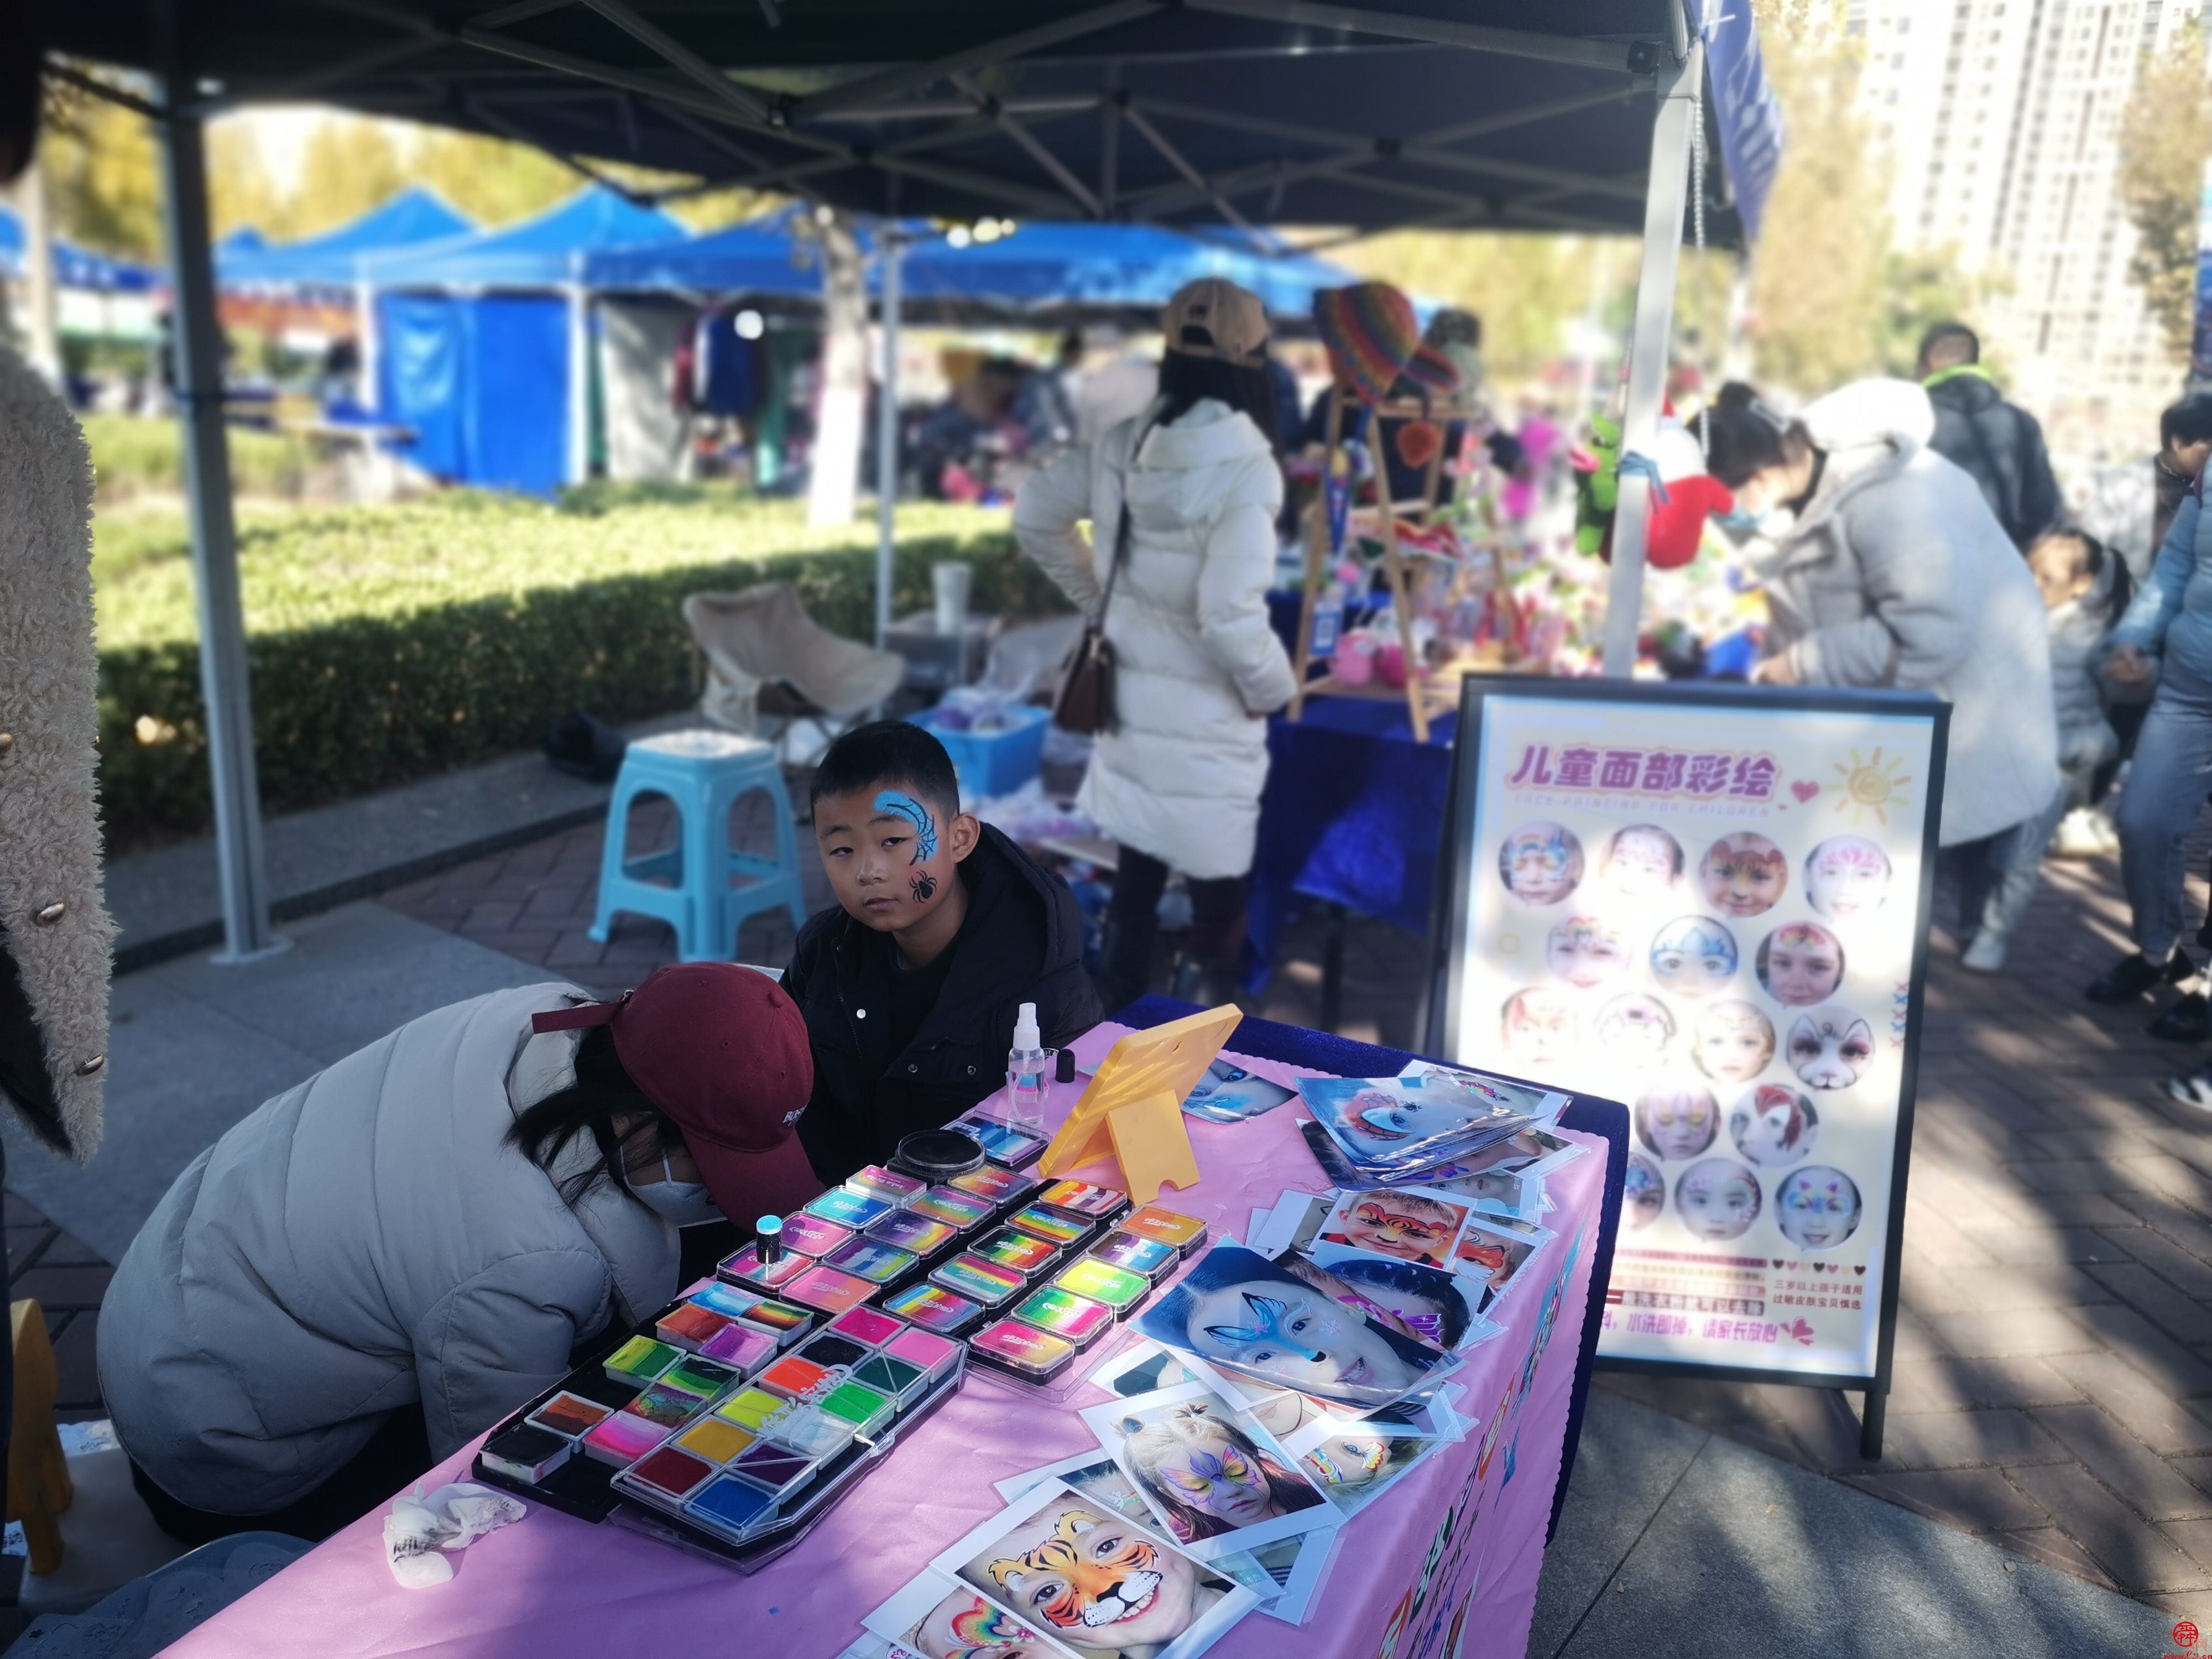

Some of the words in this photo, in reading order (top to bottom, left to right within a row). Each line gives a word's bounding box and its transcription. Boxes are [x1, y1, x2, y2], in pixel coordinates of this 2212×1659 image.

[1510, 743, 1777, 797] 儿童面部彩绘
[1772, 1294, 1861, 1310] 过敏皮肤宝贝慎选
